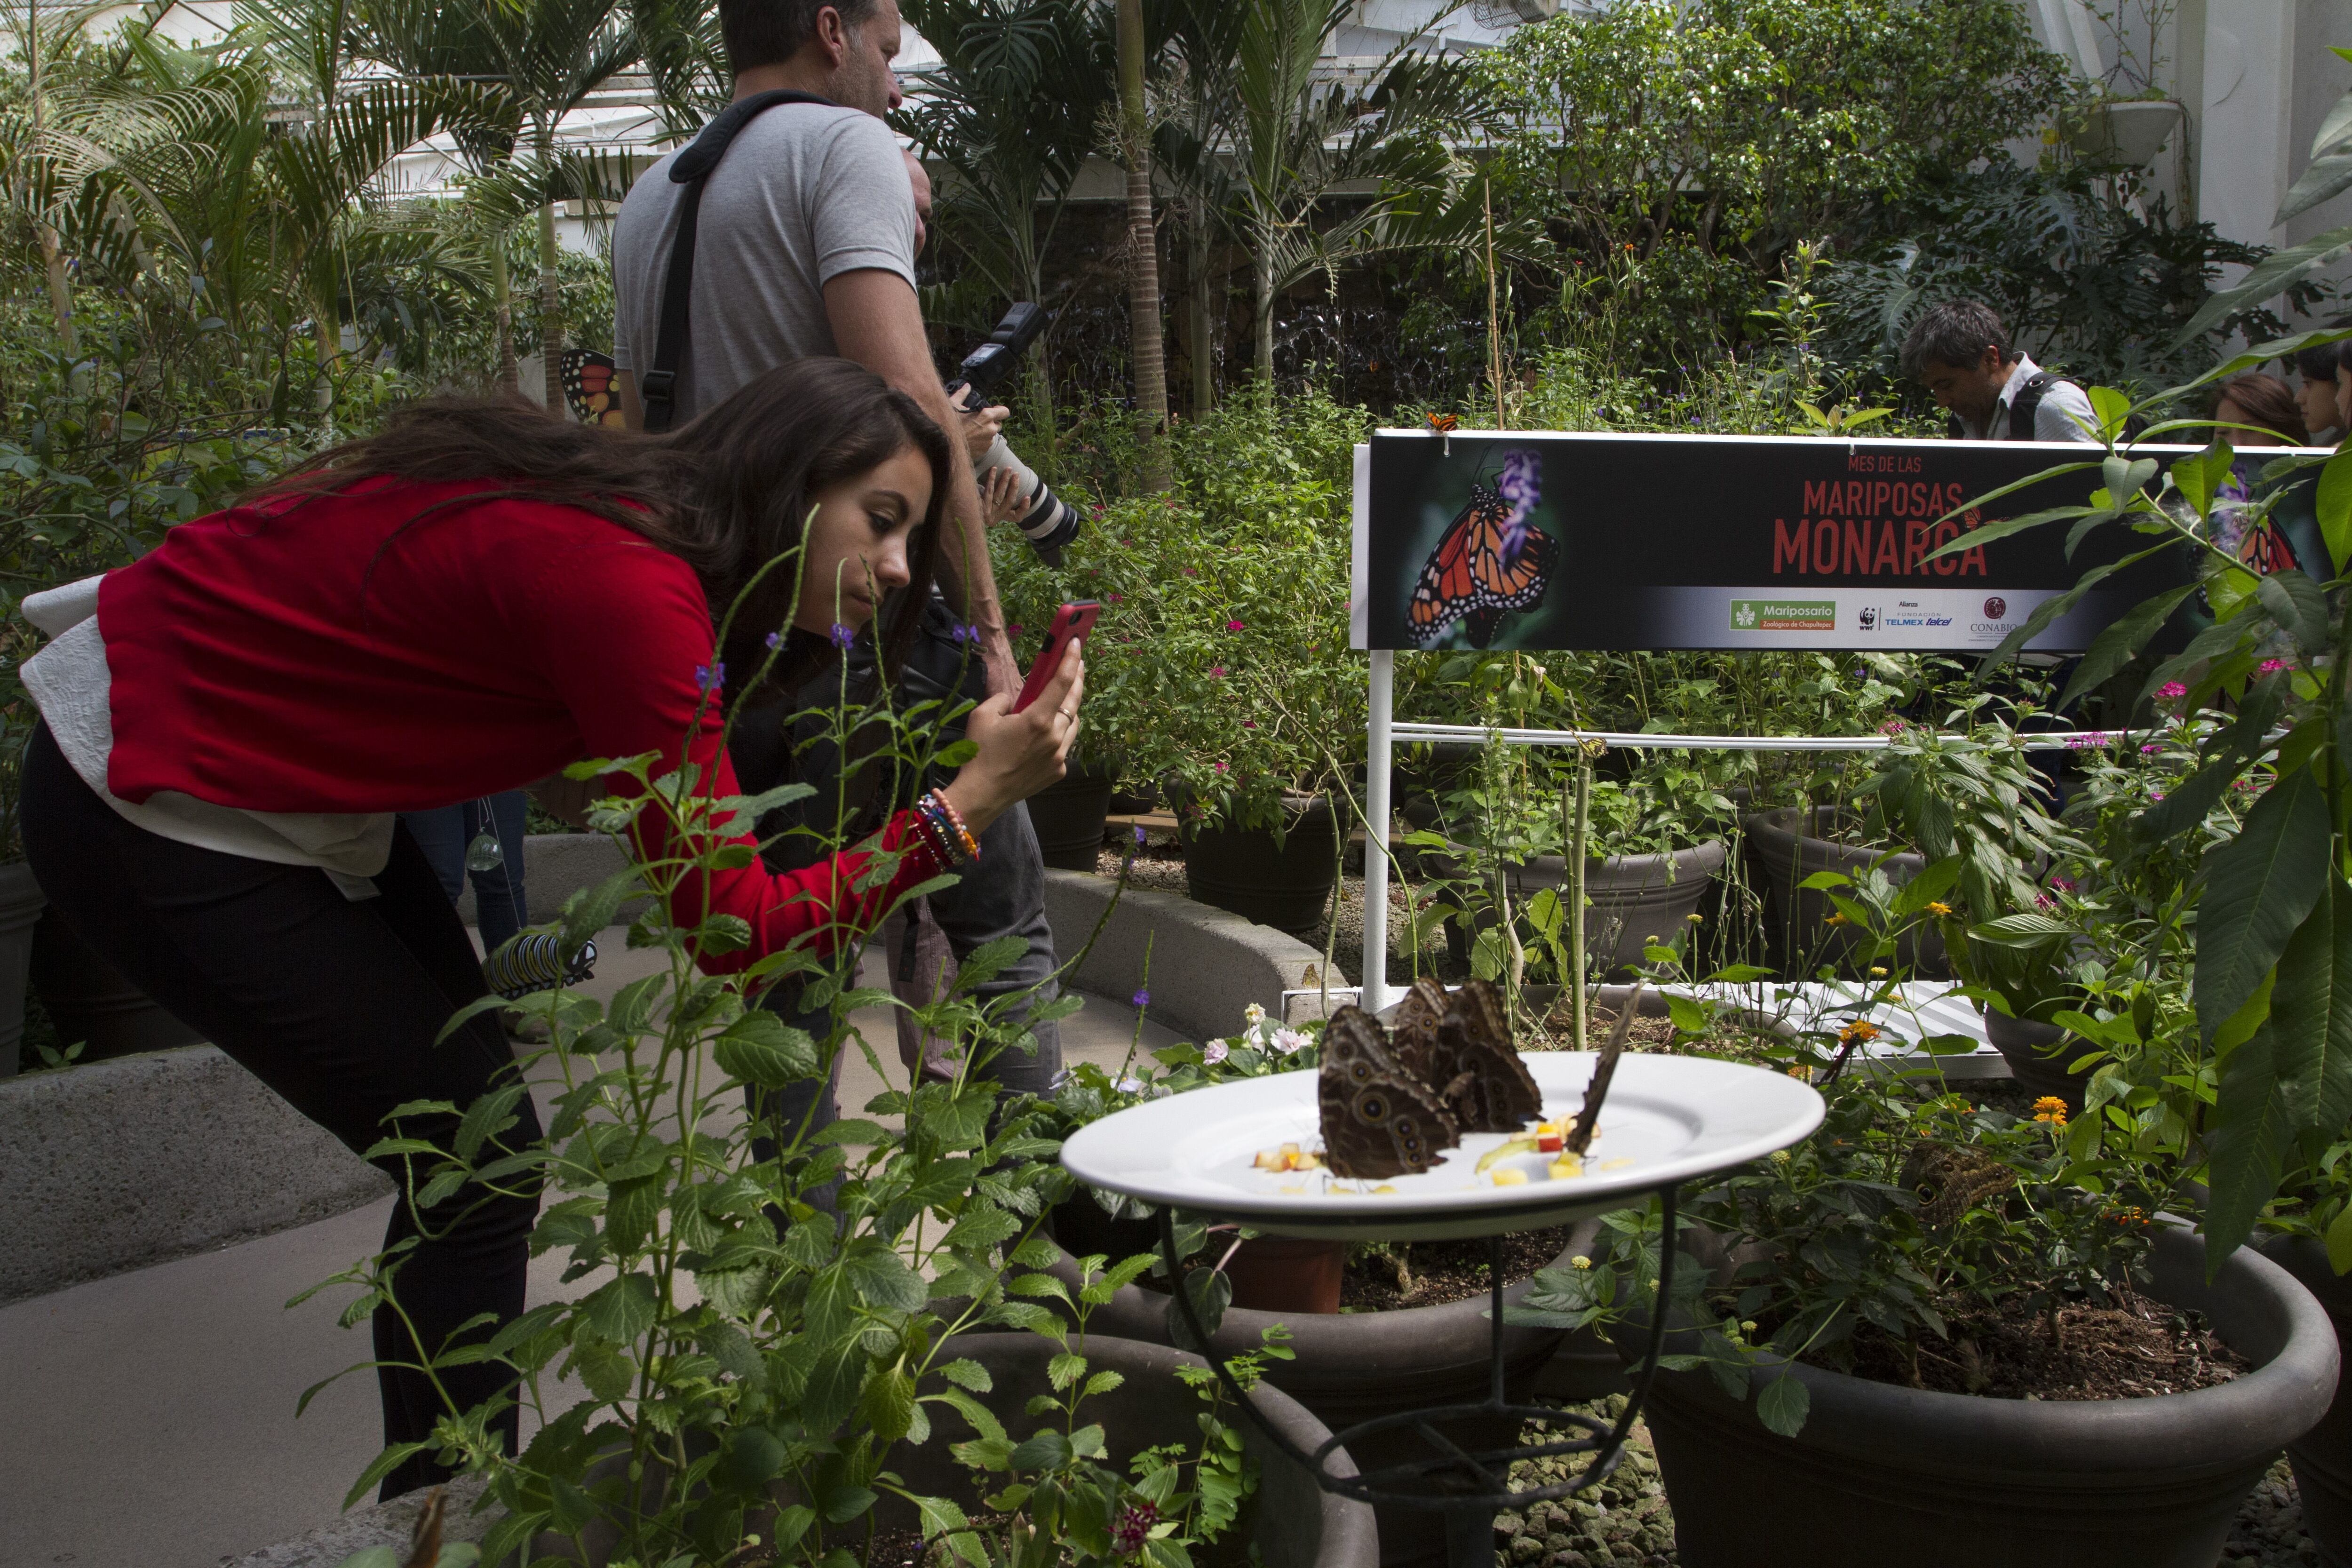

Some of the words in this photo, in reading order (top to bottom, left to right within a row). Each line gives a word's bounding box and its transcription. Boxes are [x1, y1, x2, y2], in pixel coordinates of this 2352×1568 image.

[1849, 455, 1874, 471] MES
[1878, 456, 1894, 472] DE
[1898, 456, 1922, 472] LAS
[1803, 480, 1963, 517] MARIPOSAS
[1764, 605, 1832, 617] Mariposario
